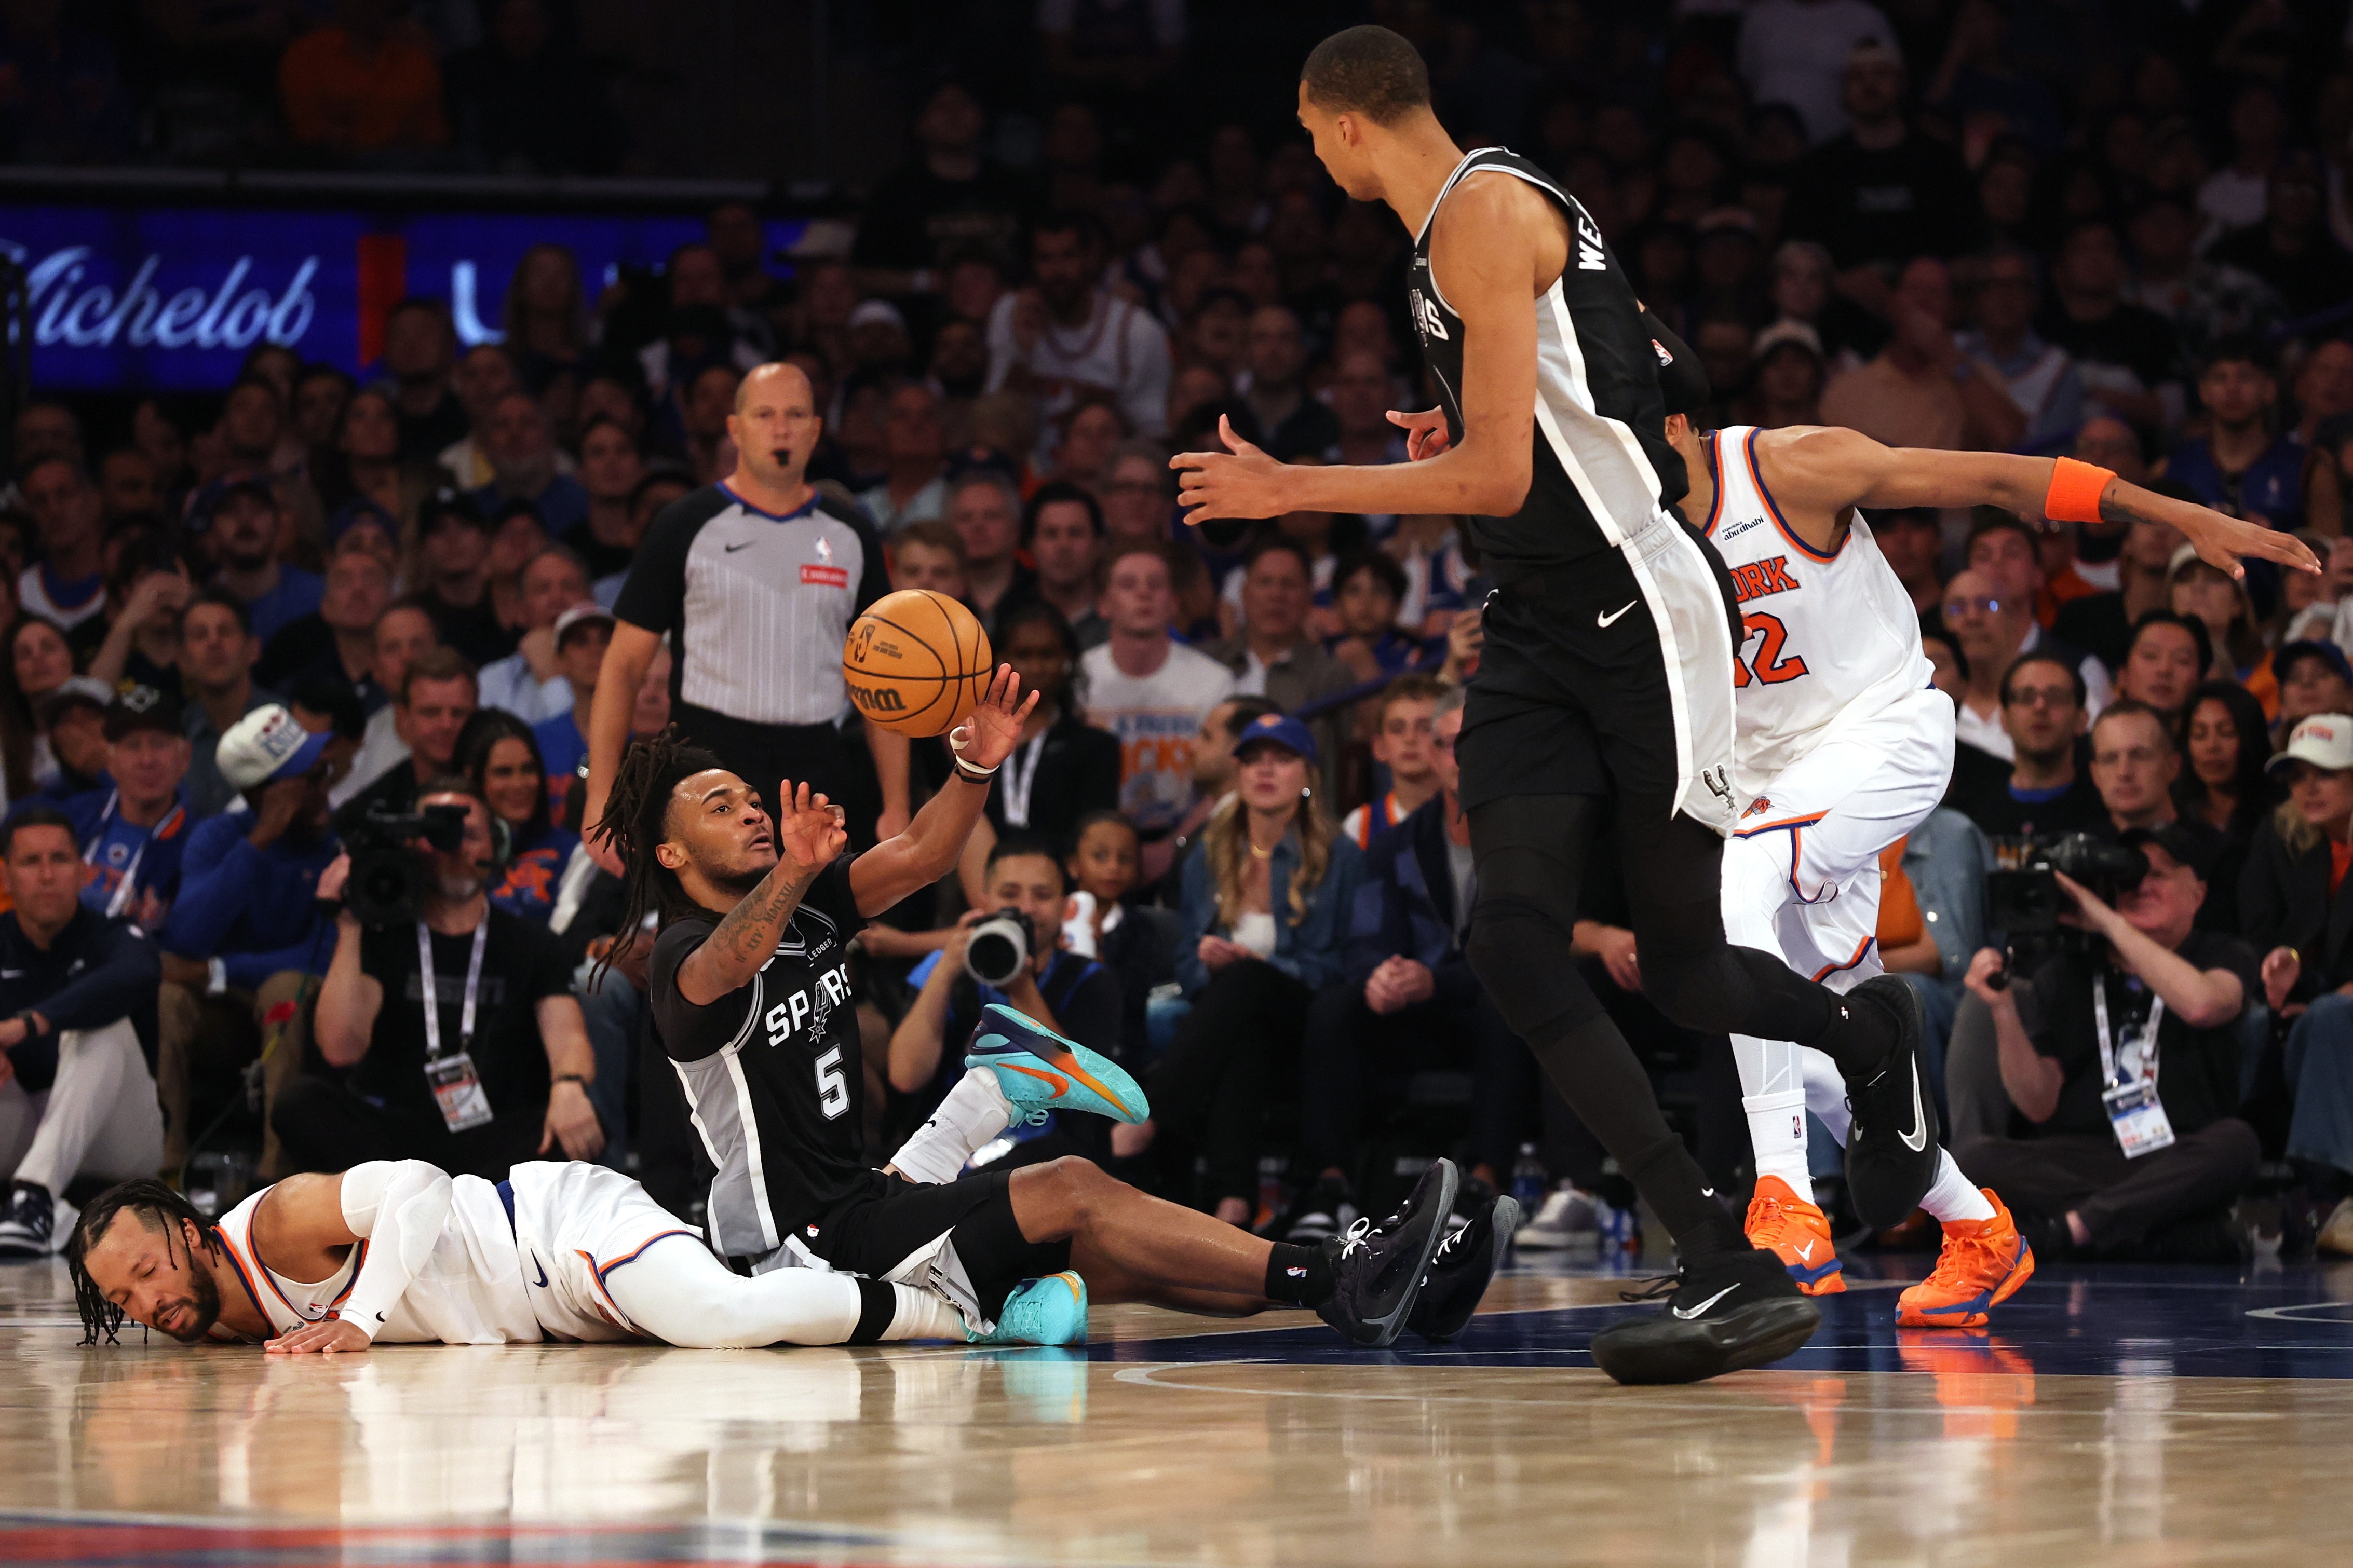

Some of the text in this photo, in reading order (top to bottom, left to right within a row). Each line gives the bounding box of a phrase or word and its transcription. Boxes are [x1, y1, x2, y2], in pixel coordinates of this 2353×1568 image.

[1572, 203, 1606, 271] WE
[1722, 521, 1743, 533] experience
[1724, 515, 1764, 540] abu dhabi
[1729, 554, 1802, 604] ORK
[807, 938, 833, 961] LEDGER
[814, 1042, 850, 1121] 5
